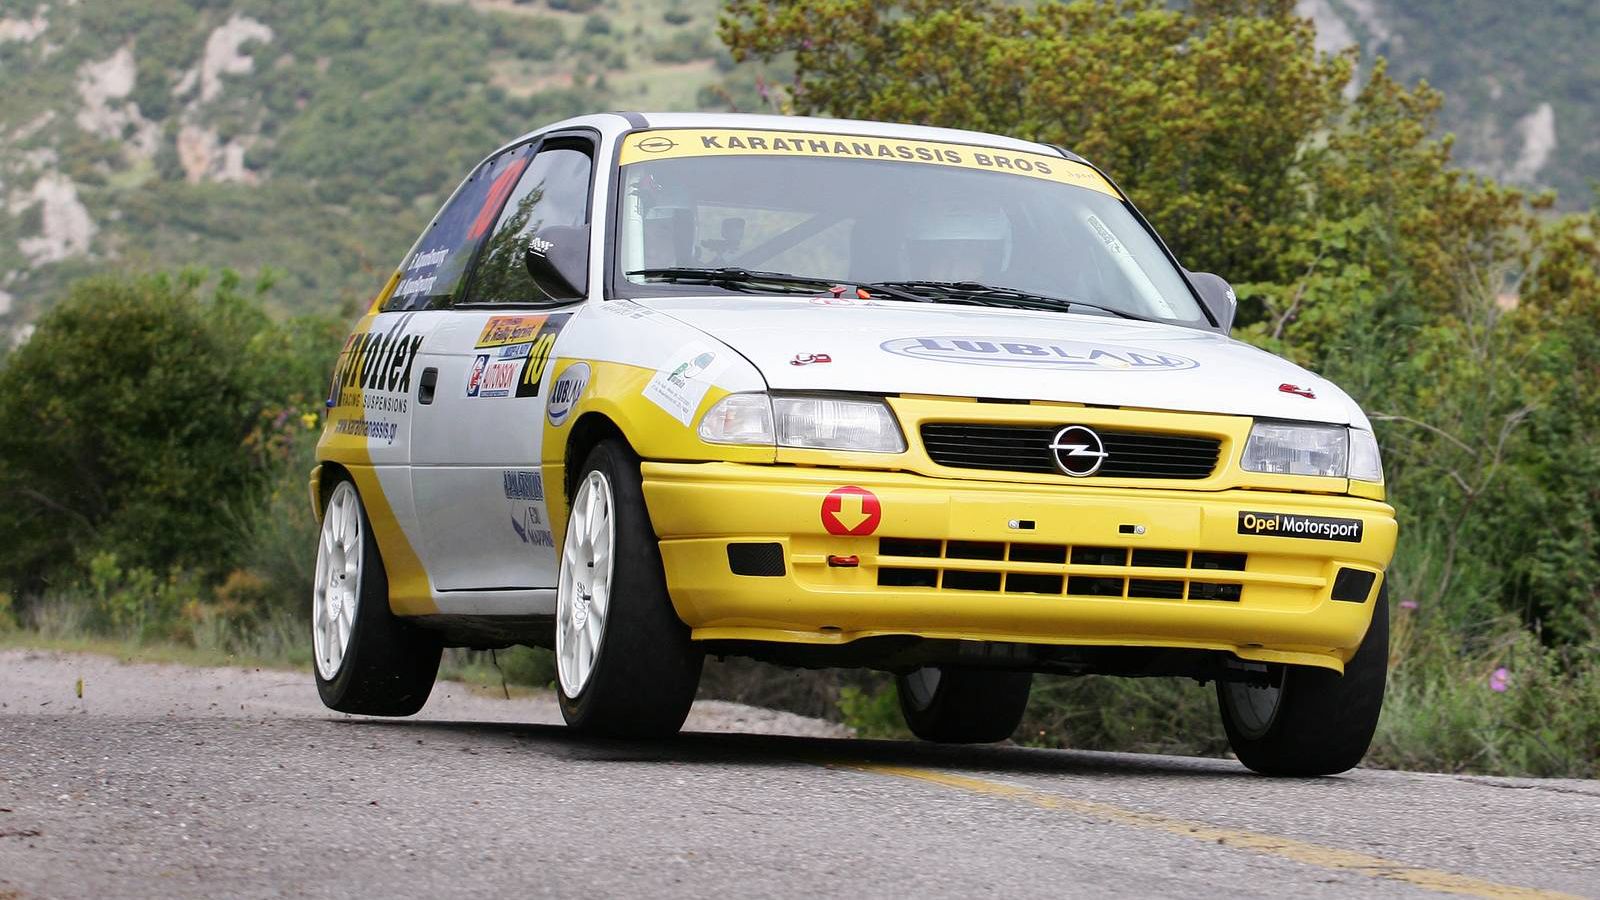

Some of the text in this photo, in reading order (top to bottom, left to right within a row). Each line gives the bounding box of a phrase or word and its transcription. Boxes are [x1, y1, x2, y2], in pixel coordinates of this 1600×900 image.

[700, 135, 962, 164] KARATHANASSIS
[974, 153, 1053, 175] BROS
[524, 332, 558, 385] 10
[915, 338, 1184, 367] LUBLAN
[363, 394, 408, 414] SUSPENSIONS
[1243, 513, 1359, 539] Opel Motorsport
